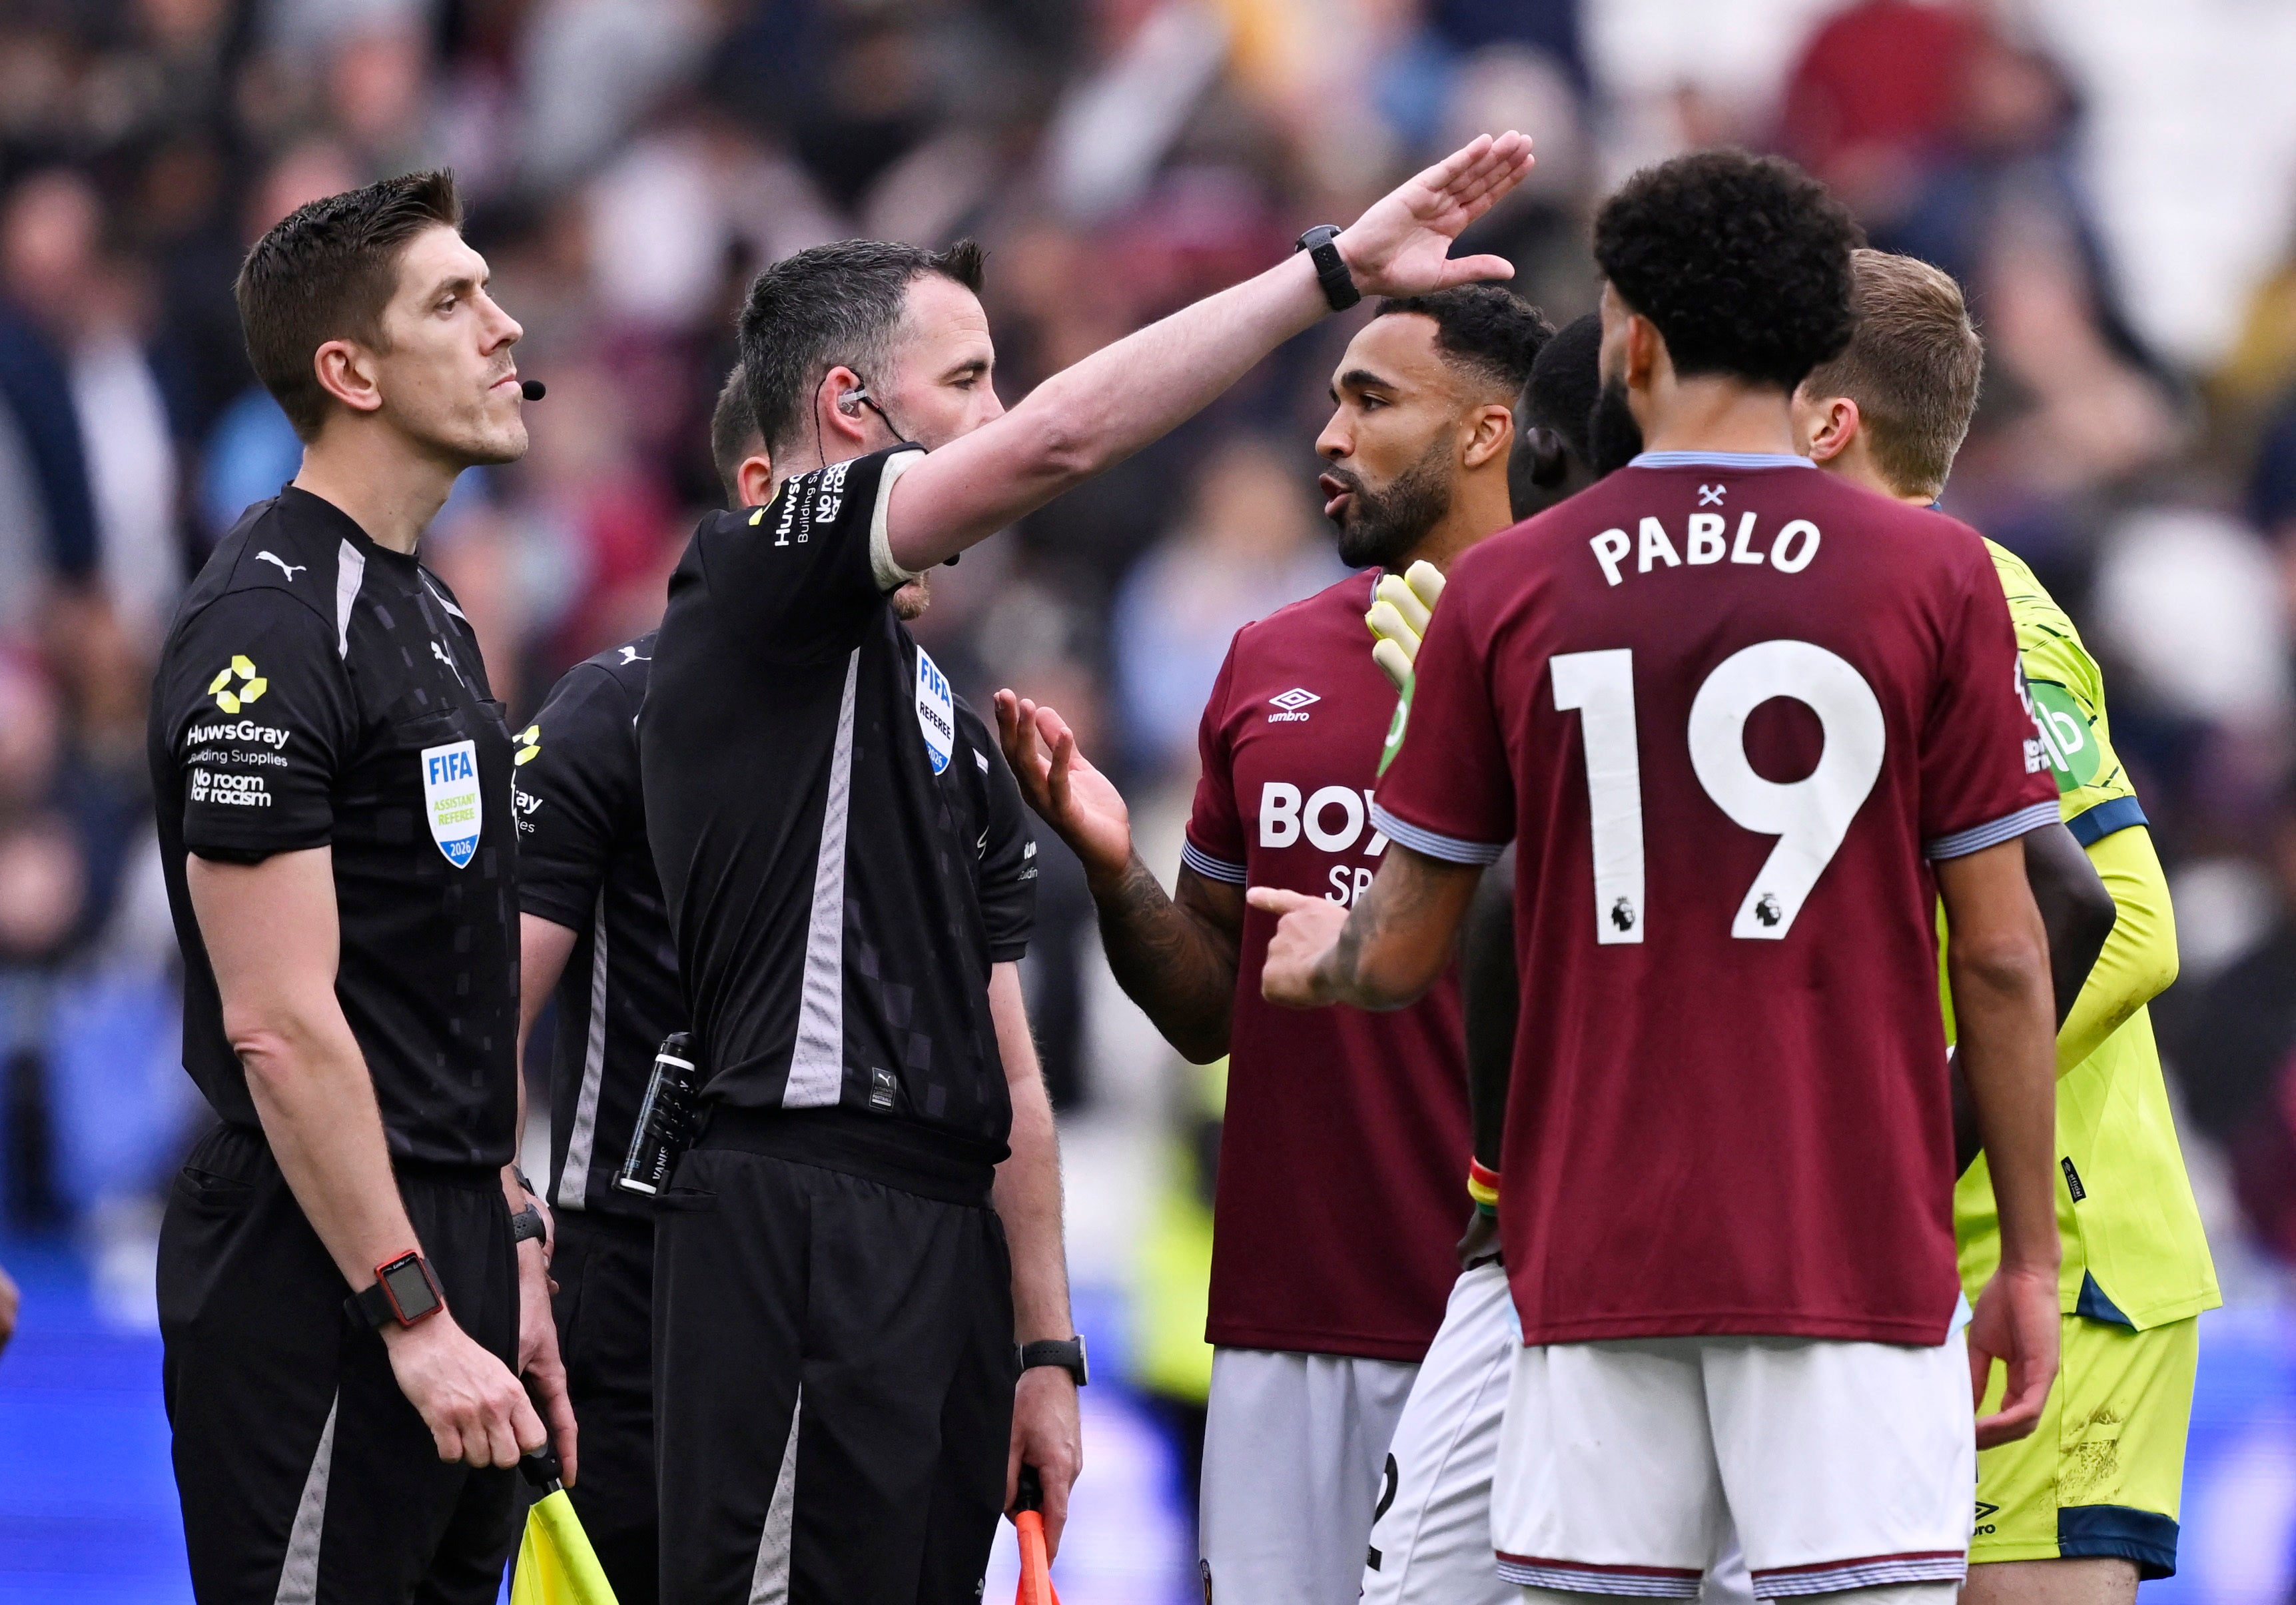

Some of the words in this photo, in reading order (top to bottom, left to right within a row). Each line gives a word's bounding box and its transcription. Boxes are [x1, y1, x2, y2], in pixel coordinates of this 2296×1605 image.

[820, 463, 839, 492] roo
[775, 472, 808, 546] Huws
[798, 487, 816, 543] Building
[815, 494, 832, 523] No
[1589, 511, 1821, 587] PABLO
[921, 656, 951, 710] FIFA
[920, 701, 951, 740] REFEREE
[1268, 710, 1310, 723] umbro
[187, 720, 289, 749] HuwsGray
[231, 749, 288, 767] Supplies
[429, 752, 473, 785] FIFA
[927, 747, 943, 769] 2026
[193, 768, 211, 787] No
[213, 774, 264, 792] room
[1549, 639, 1886, 944] 19
[210, 788, 272, 807] racism
[434, 793, 476, 812] ASSISTANT
[438, 808, 476, 826] REFEREE
[450, 840, 472, 857] 2026
[652, 1146, 669, 1181] VANIS
